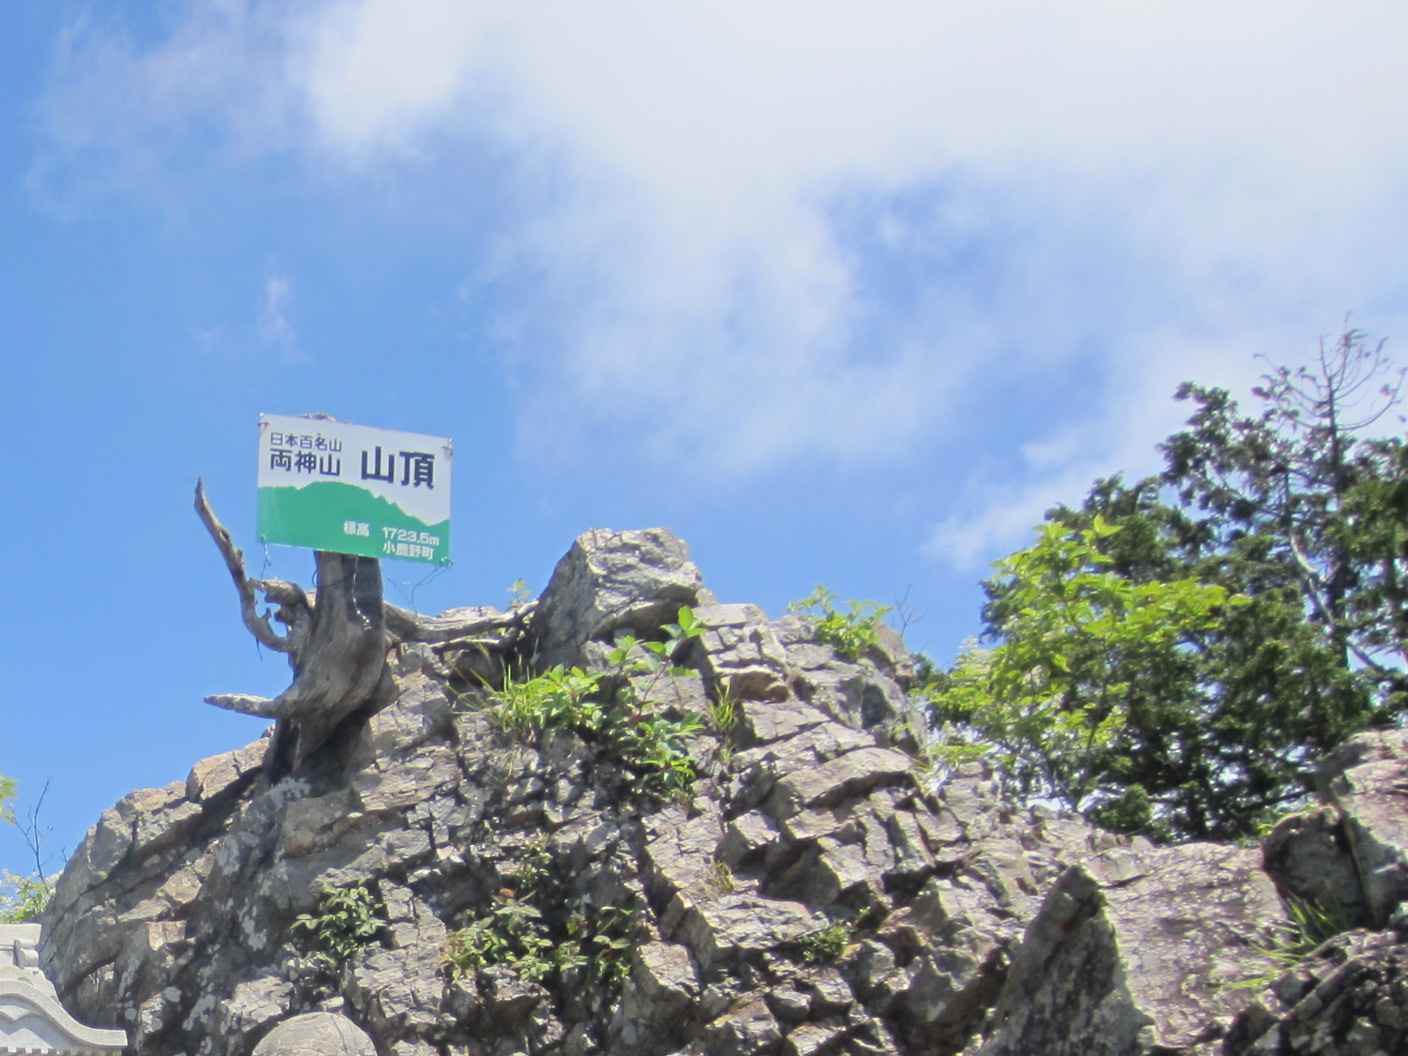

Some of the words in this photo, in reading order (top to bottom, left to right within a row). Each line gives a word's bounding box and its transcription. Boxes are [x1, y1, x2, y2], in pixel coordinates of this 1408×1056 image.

[270, 432, 342, 452] 日本百名山
[270, 448, 341, 476] 両神山
[361, 446, 435, 490] 山頂
[382, 526, 440, 546] 1723.5m
